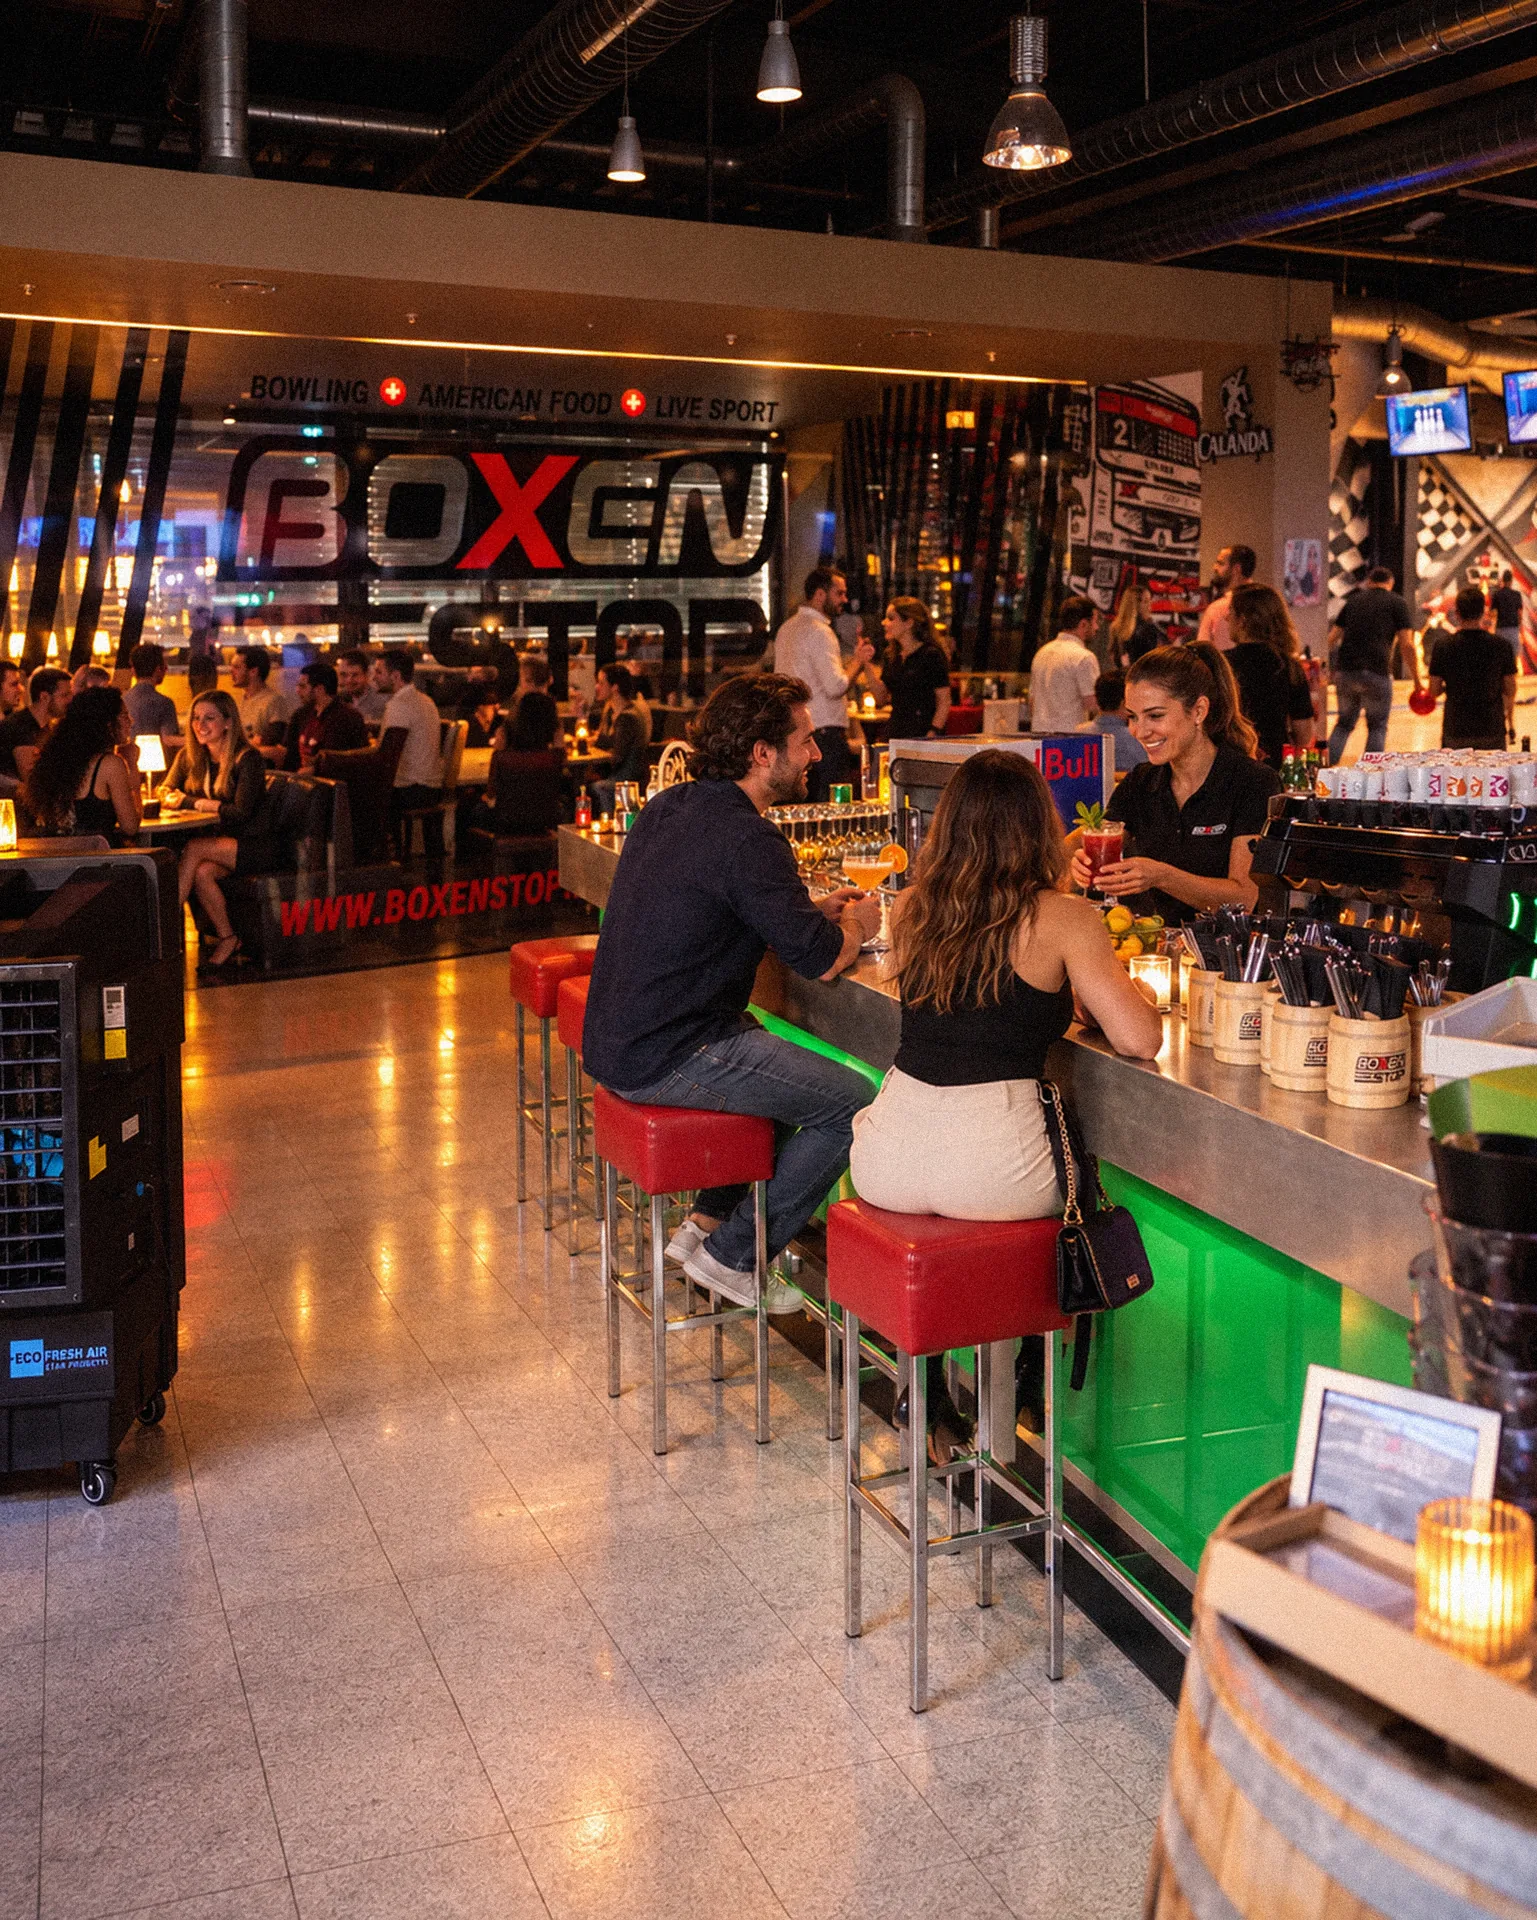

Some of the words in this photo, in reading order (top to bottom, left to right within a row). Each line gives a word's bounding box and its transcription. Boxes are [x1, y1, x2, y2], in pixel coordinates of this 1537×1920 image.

[251, 375, 369, 404] BOWLING
[417, 383, 542, 412] AMERICAN
[550, 390, 613, 415] FOOD
[655, 395, 701, 419] LIVE
[708, 400, 779, 423] SPORT
[1113, 418, 1129, 447] 2
[1199, 429, 1269, 461] CALANDA
[228, 440, 780, 575] BOXEN
[1045, 743, 1099, 781] Bull
[44, 1348, 83, 1362] FRESH
[86, 1345, 108, 1359] AIR
